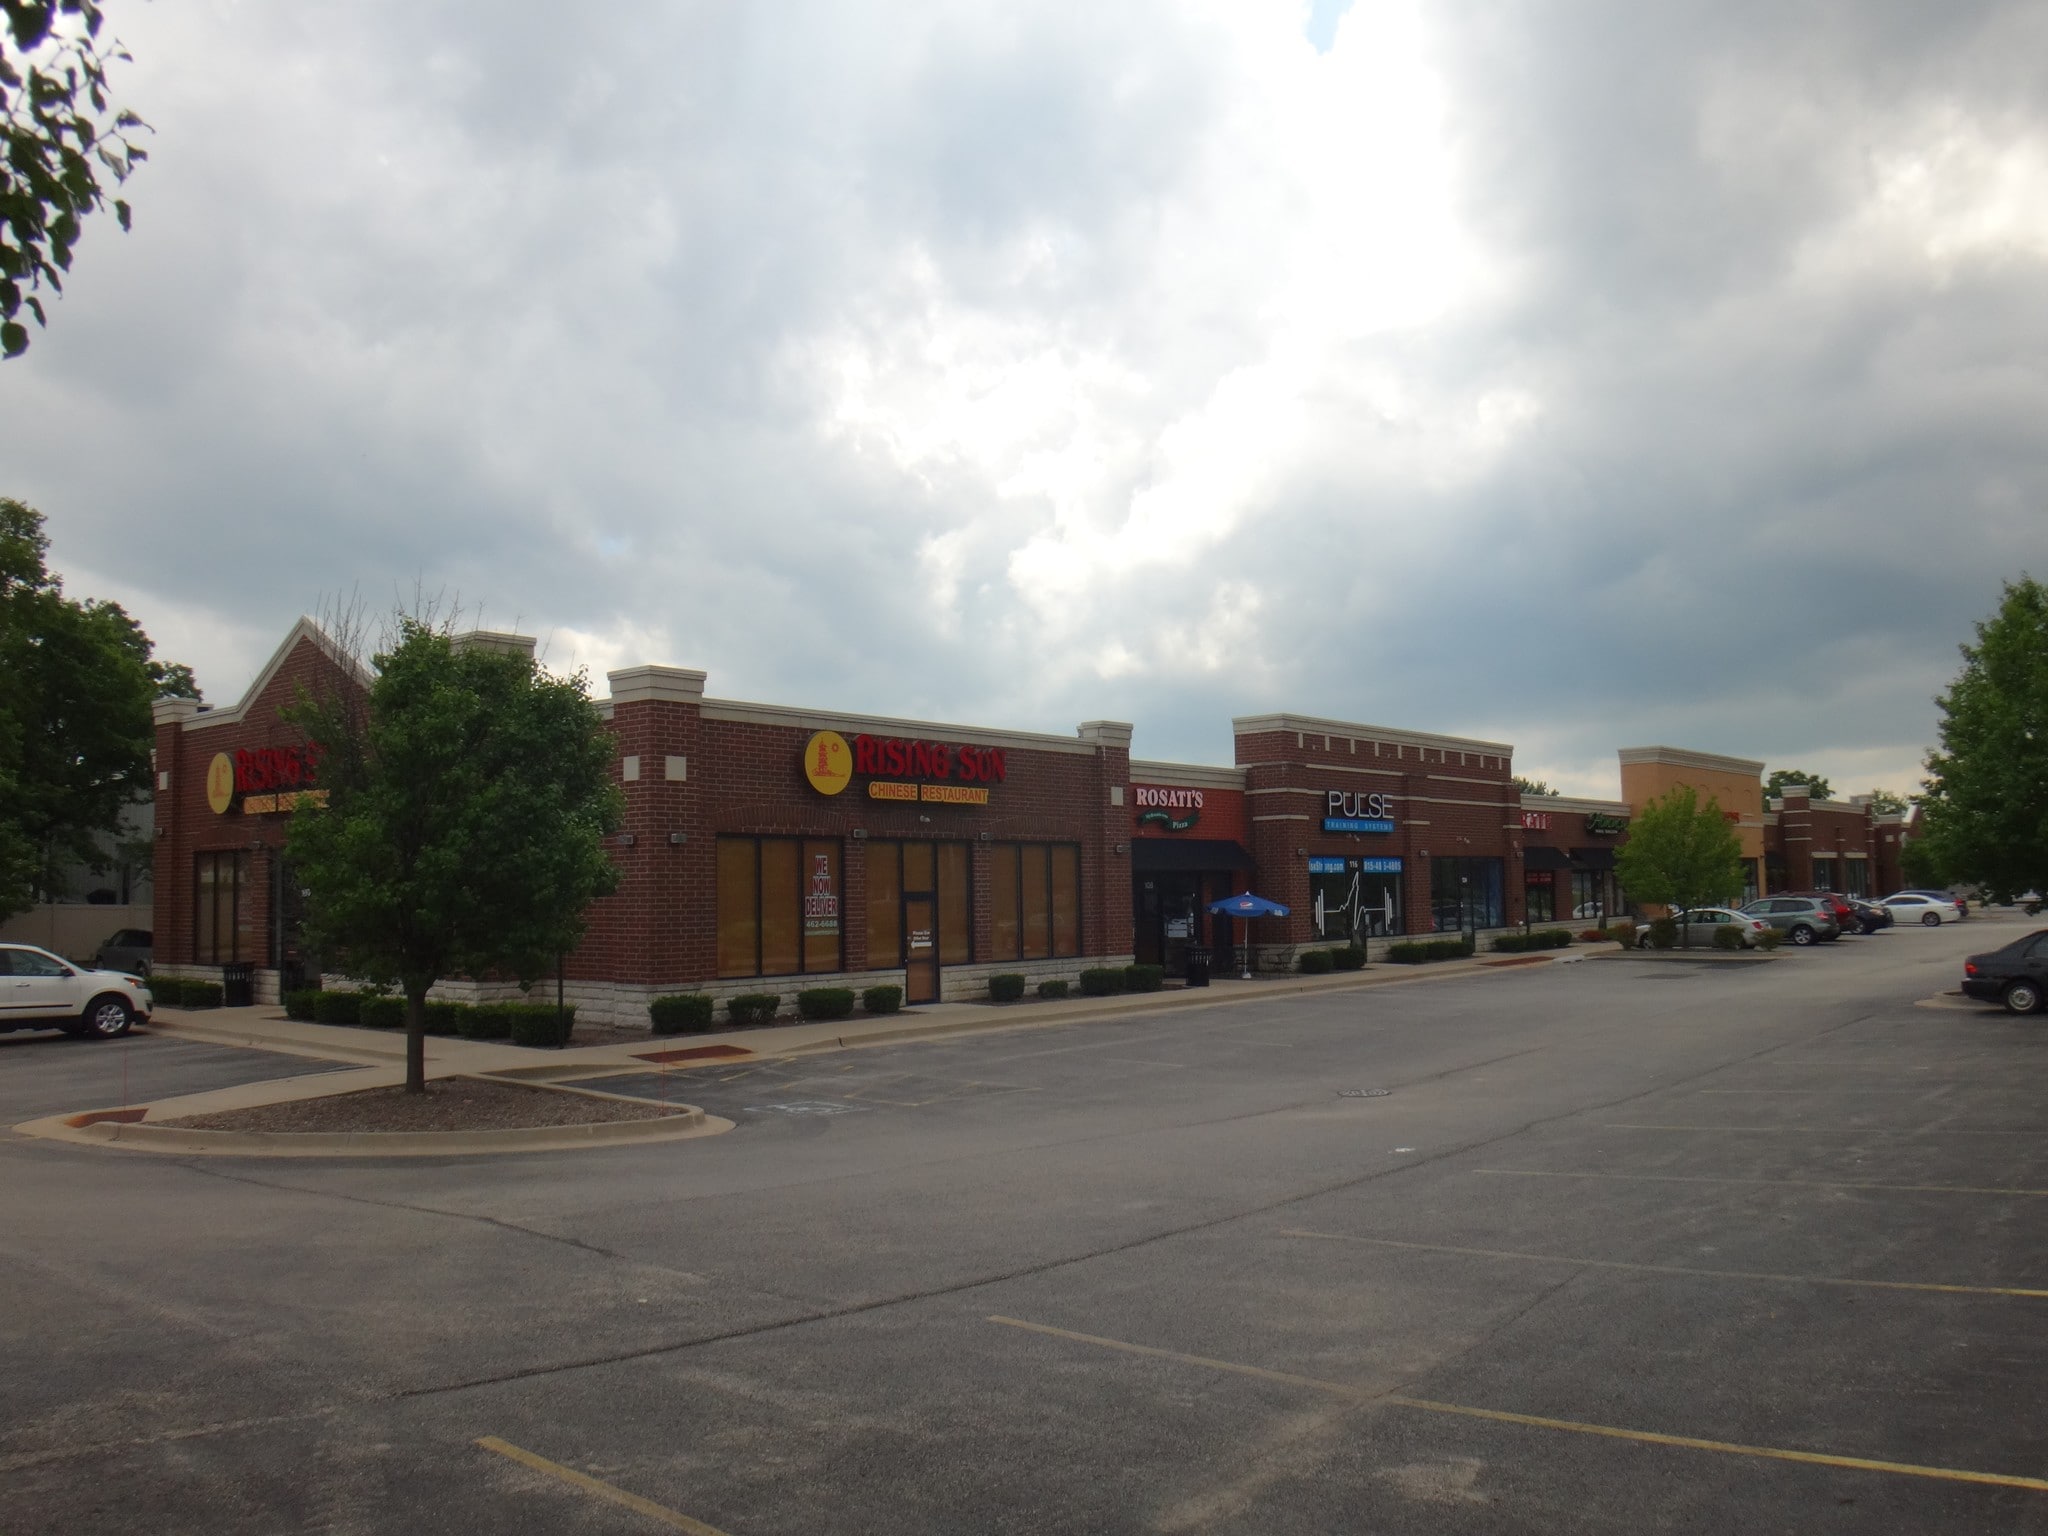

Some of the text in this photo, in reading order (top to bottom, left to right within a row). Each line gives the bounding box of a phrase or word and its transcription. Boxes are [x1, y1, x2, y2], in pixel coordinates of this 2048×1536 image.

[855, 734, 1007, 782] RISING SUN
[870, 783, 988, 803] CHINESE RESTAURANT
[1136, 788, 1203, 808] ROSATI'S
[1328, 790, 1395, 818] PULSE
[1172, 821, 1188, 829] Pizza
[1326, 821, 1359, 829] TRAINING
[816, 856, 827, 874] WE
[813, 877, 830, 895] NOW
[806, 897, 837, 917] DELIVER
